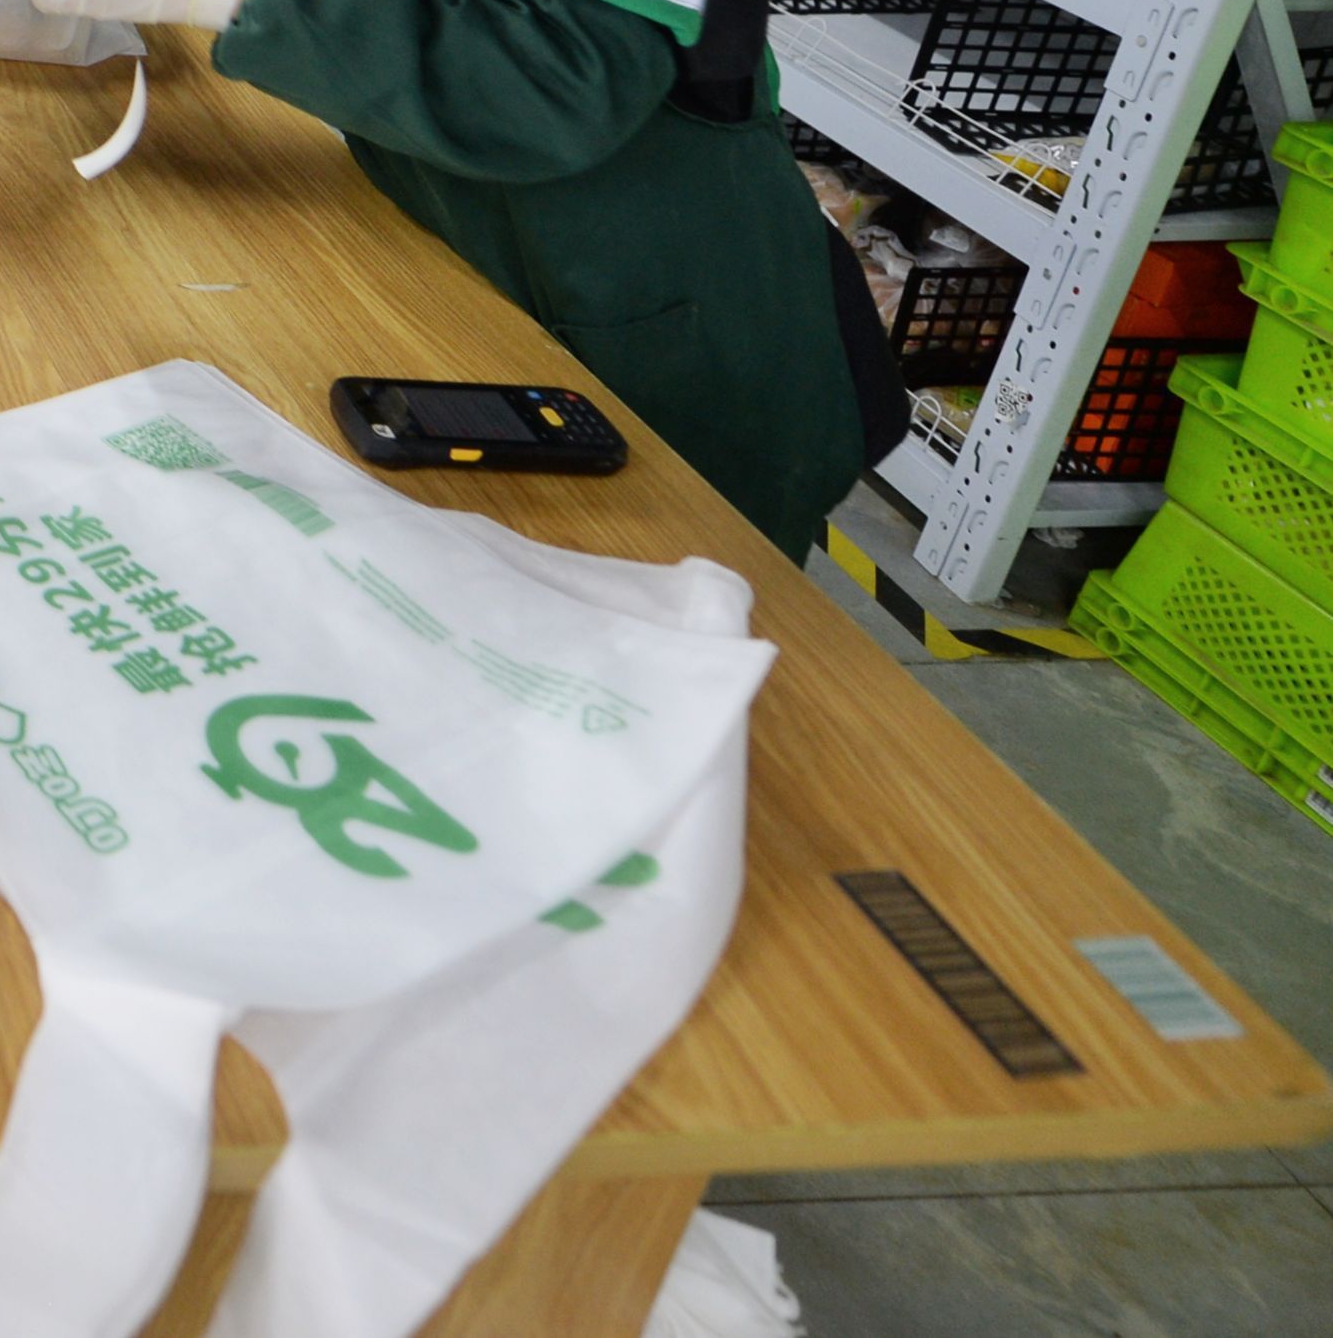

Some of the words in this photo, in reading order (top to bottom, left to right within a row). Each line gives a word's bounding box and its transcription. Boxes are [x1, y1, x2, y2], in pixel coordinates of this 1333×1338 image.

[39, 504, 260, 679] 抢鲜到家
[200, 692, 480, 881] 29
